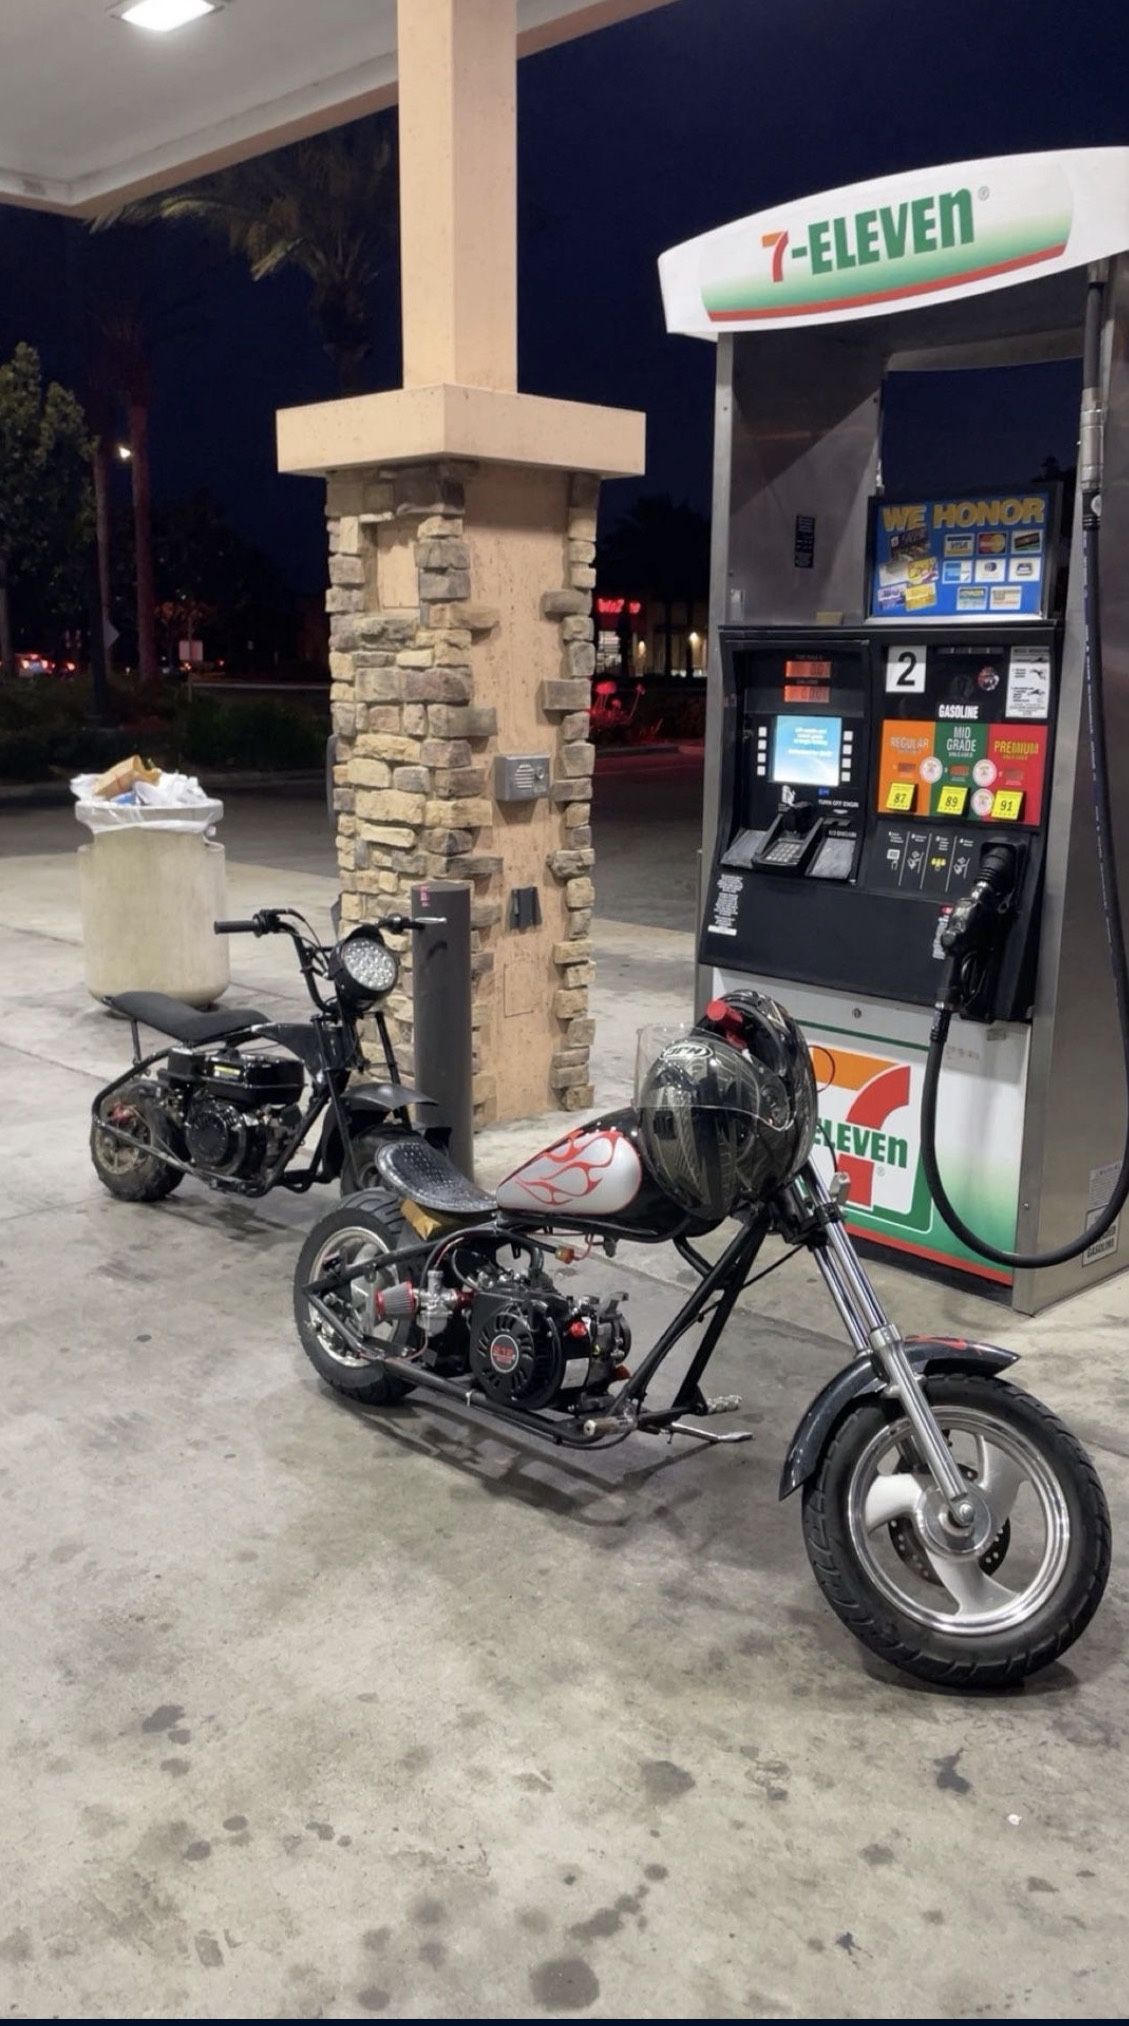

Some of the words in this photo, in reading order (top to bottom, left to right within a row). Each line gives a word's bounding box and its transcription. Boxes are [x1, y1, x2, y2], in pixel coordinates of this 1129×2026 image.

[882, 504, 927, 532] WE
[932, 496, 1046, 529] HONOR
[896, 651, 918, 687] 2
[938, 704, 979, 719] GASOLINE
[953, 726, 971, 738] MID
[890, 736, 929, 749] REGULAR
[946, 737, 977, 752] GRADE
[994, 740, 1039, 755] PREMIUM
[893, 793, 907, 804] 87
[945, 795, 958, 808] 89
[1000, 799, 1013, 812] 91
